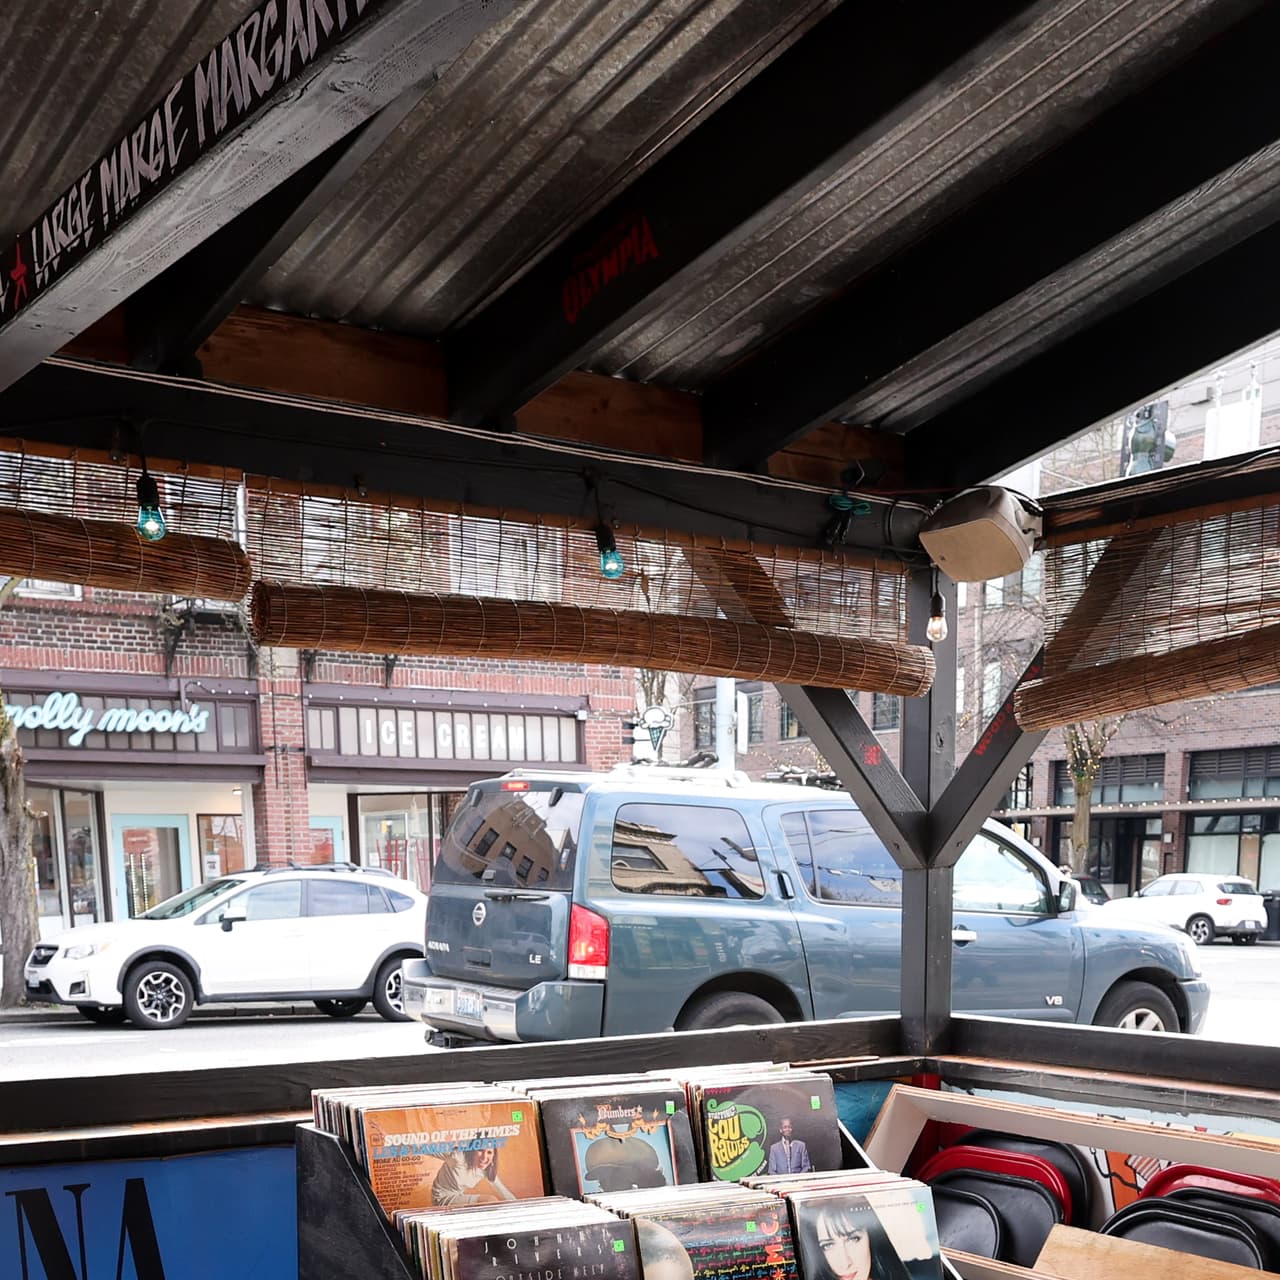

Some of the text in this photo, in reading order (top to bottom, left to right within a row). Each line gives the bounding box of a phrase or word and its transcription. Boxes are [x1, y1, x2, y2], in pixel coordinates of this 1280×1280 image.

[31, 170, 94, 289] LARGE
[365, 719, 525, 751] ICE CREAM
[383, 1124, 521, 1148] SOUND OF THE TIMES
